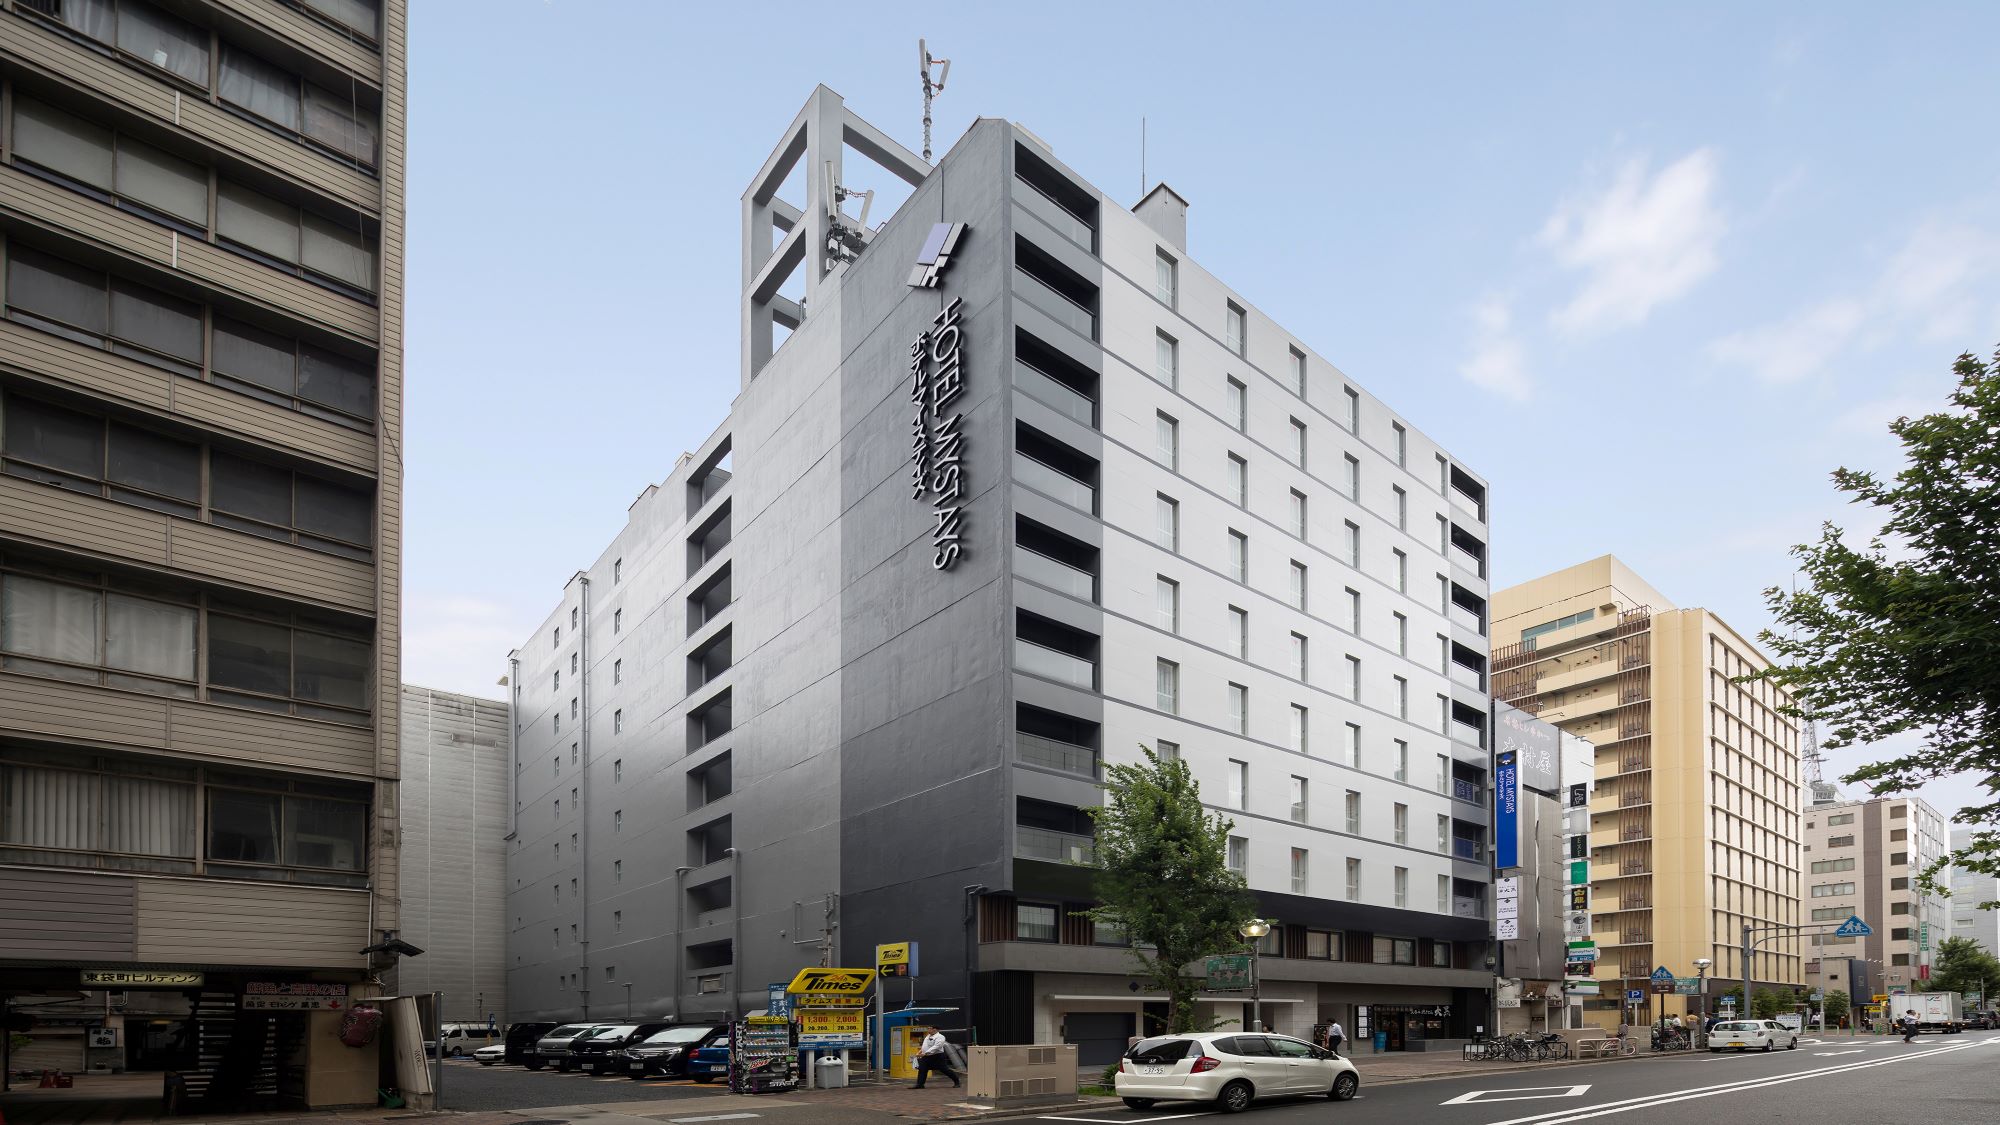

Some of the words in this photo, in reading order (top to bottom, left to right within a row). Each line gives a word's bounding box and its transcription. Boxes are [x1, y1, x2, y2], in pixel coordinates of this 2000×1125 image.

[933, 296, 962, 418] HOTEL
[911, 331, 930, 500] ホテルマイステイズ
[933, 413, 963, 570] MYSTAYS
[1505, 768, 1515, 787] HOTEL
[1505, 788, 1515, 814] MYSTAYS
[803, 973, 866, 991] Times
[735, 1022, 744, 1062] START
